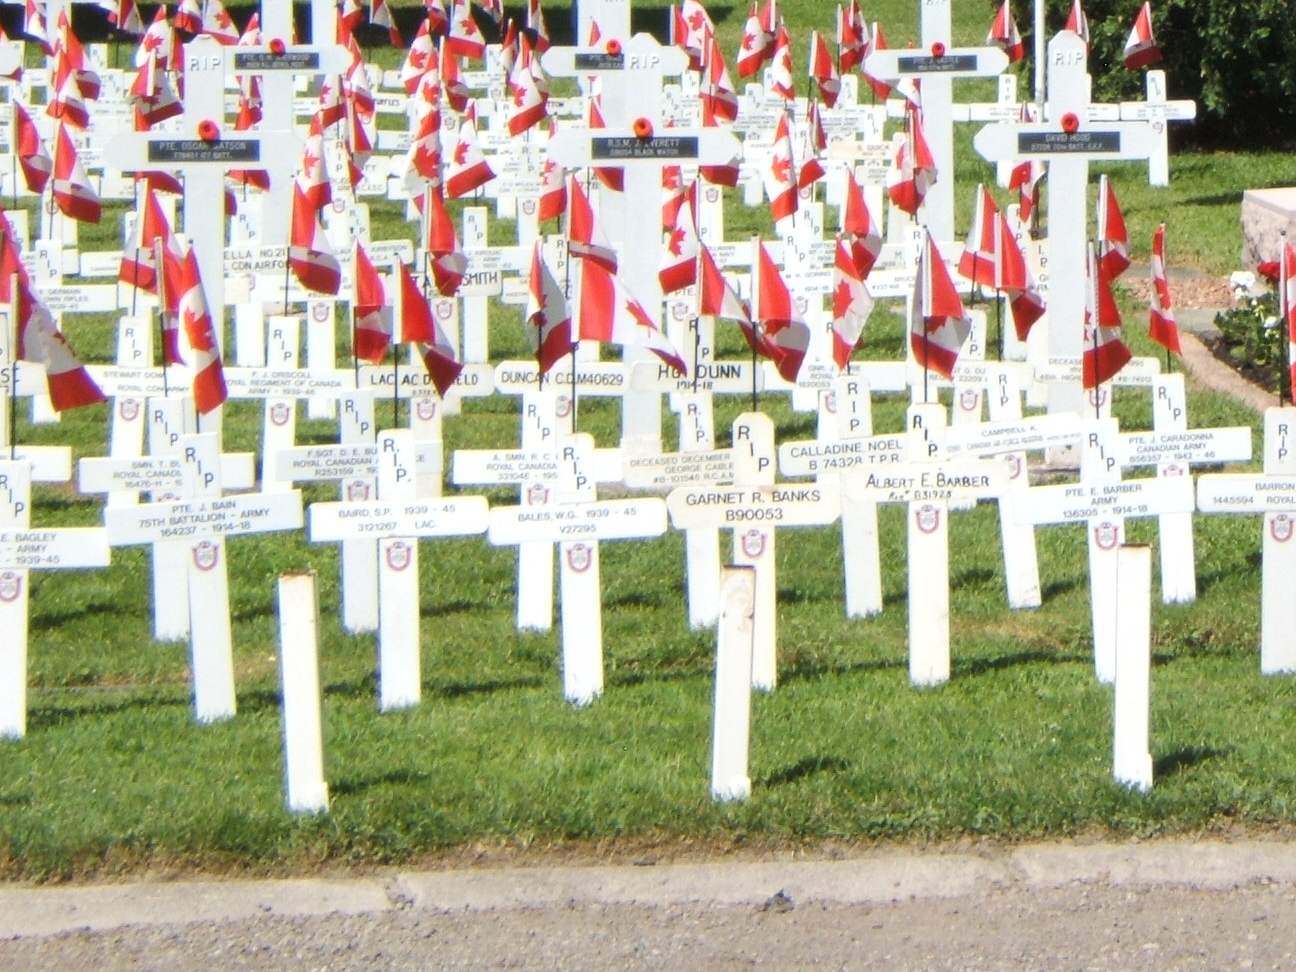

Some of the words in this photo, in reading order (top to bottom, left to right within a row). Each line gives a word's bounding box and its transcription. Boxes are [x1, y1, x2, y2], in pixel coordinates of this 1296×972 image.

[159, 141, 177, 151] PTE.
[254, 260, 271, 270] AIR
[463, 271, 498, 288] SMITH
[501, 371, 551, 385] DUNCAN
[696, 365, 742, 380] DUNN
[227, 379, 247, 387] OYAL
[308, 379, 342, 387] CANADA
[370, 373, 395, 386] LAC
[981, 426, 1026, 438] CAMPBELL
[1151, 435, 1158, 444] J.
[1160, 432, 1215, 443] CARADONNA
[868, 439, 903, 452] NOEL
[1137, 444, 1180, 454] CANADIAN
[1183, 442, 1207, 452] ARMY
[293, 459, 322, 468] ROYAL
[325, 457, 374, 467] CANADIAN
[630, 456, 678, 467] DECEASED
[681, 453, 731, 464] DECEMBER
[486, 462, 515, 471] ROYAL
[518, 462, 558, 471] CANADIA
[665, 464, 702, 474] GEORGE
[113, 471, 141, 479] ROYAL
[865, 473, 916, 490] ALBERT
[936, 472, 990, 489] BARBER
[1065, 488, 1086, 498] PTE.
[1090, 487, 1099, 496] E.
[1103, 484, 1143, 495] BARBER
[686, 491, 744, 506] GARNET
[752, 491, 766, 503] R.
[772, 489, 821, 503] BANKS
[1091, 496, 1118, 507] ARMY
[1266, 495, 1296, 505] ROYAL
[172, 504, 196, 514] PTE.
[200, 503, 207, 512] J.
[211, 499, 237, 510] BAIN
[442, 504, 457, 513] 45
[586, 508, 610, 518] 1939
[623, 506, 637, 517] 45
[139, 518, 166, 529] 75TH
[169, 512, 227, 527] BATTALION
[240, 507, 270, 519] ARMY
[725, 507, 784, 522] B90053
[15, 533, 58, 544] BAGLEY
[17, 544, 48, 554] ARMY
